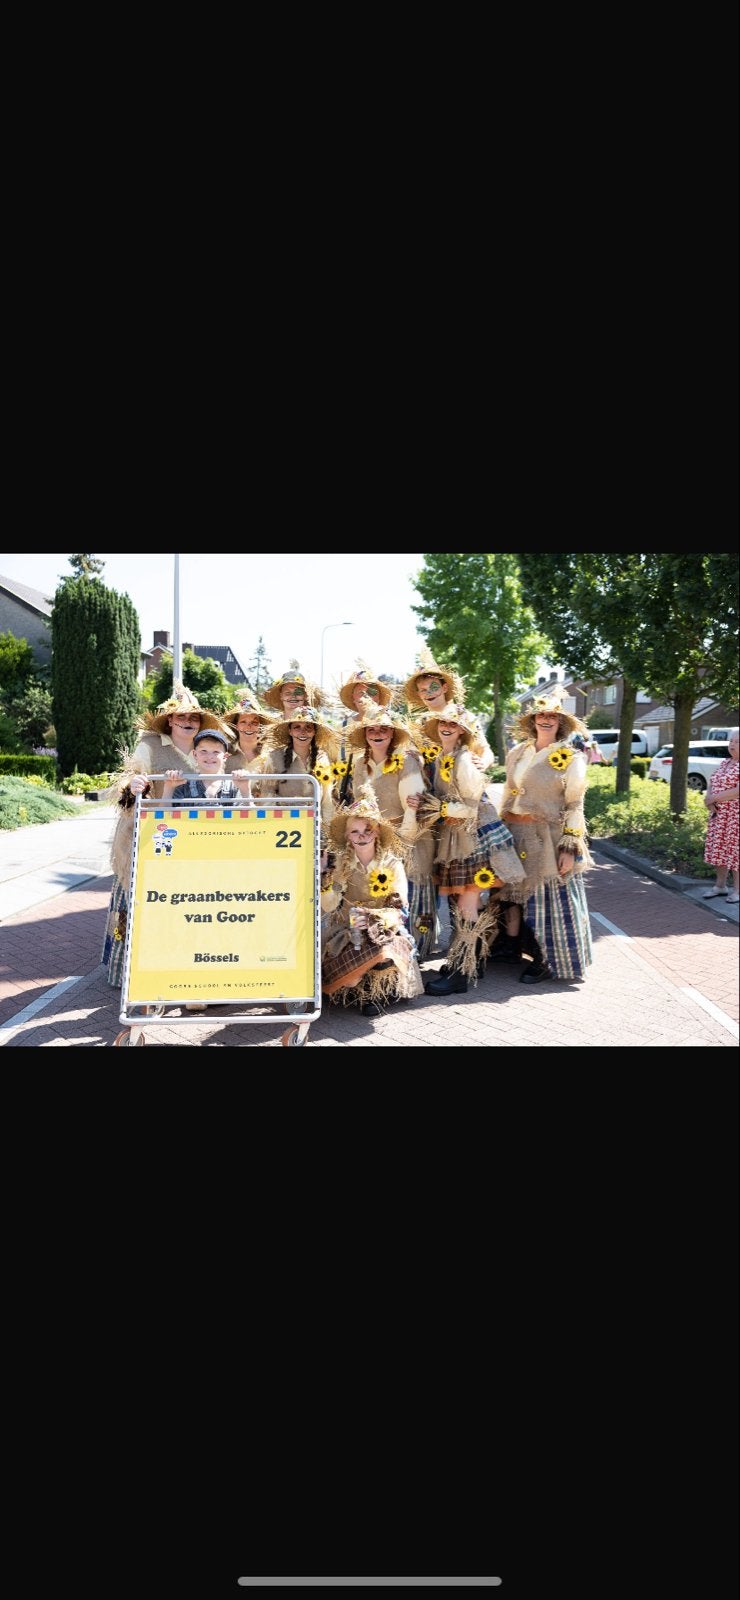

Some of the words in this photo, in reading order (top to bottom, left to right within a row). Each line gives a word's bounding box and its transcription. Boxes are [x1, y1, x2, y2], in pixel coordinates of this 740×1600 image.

[275, 830, 302, 848] 22
[146, 891, 167, 903] De
[170, 890, 291, 905] graanbewakers
[184, 913, 213, 923] van
[216, 911, 256, 923] Goor
[193, 953, 240, 963] Bössels
